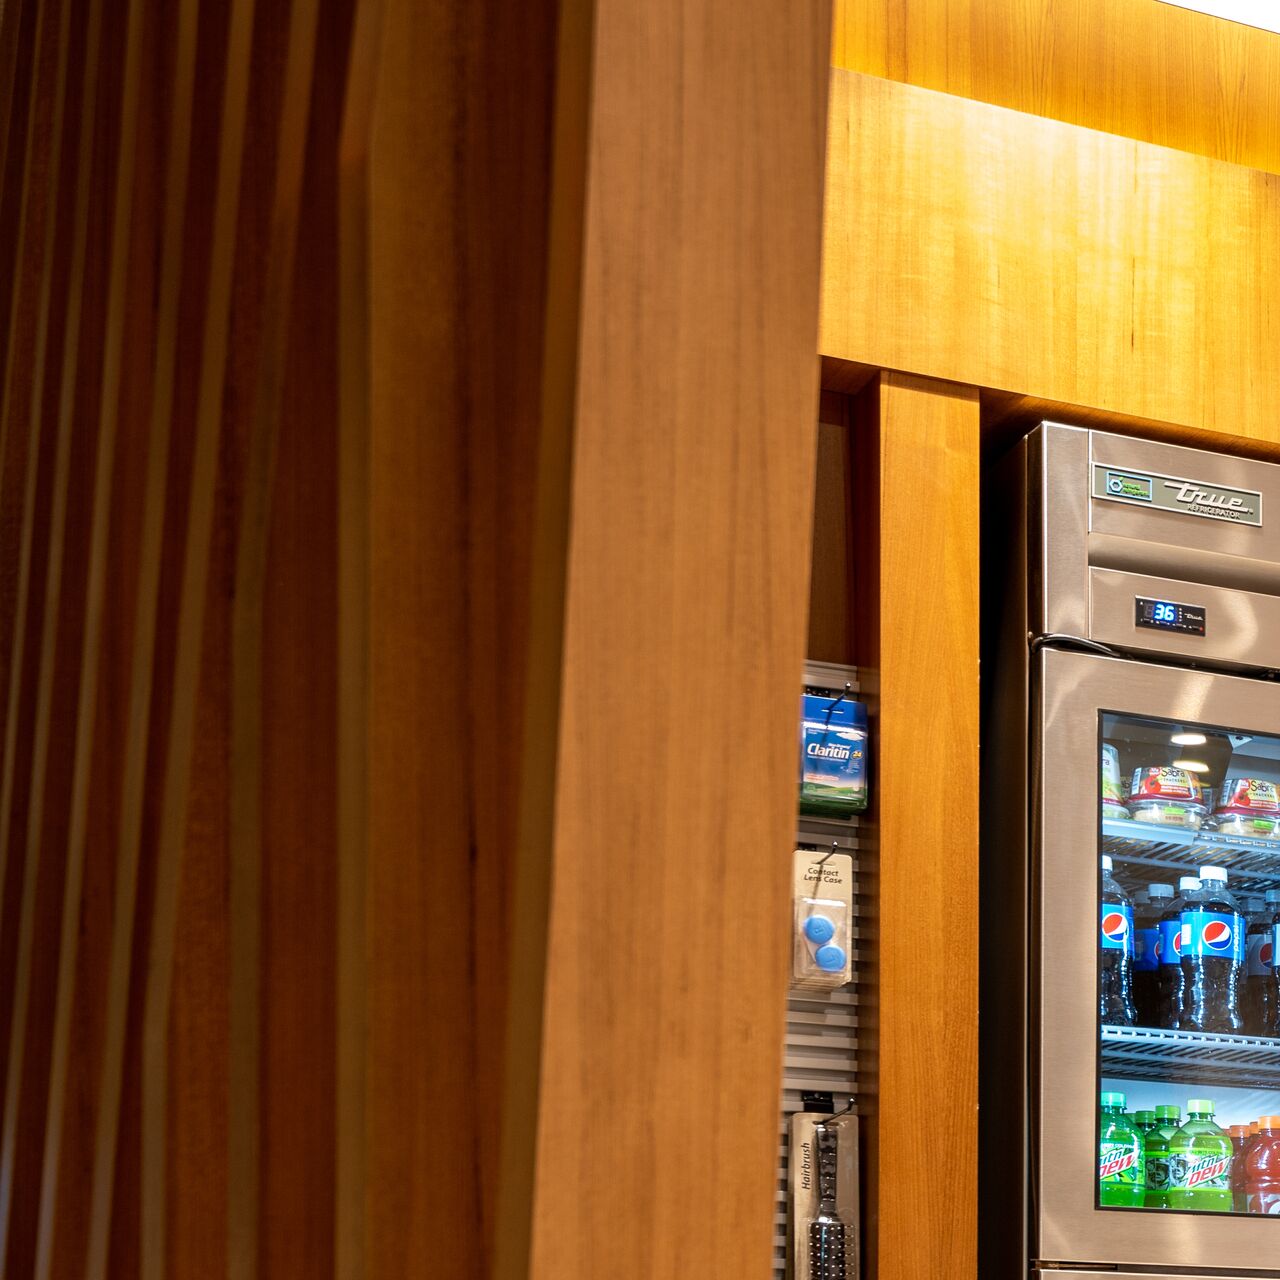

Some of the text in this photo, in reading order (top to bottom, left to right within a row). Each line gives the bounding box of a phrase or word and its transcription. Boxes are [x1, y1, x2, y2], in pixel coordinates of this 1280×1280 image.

[1188, 504, 1240, 519] REFRIGERATOR
[1154, 604, 1174, 620] 36
[807, 743, 850, 759] Claritin
[1161, 767, 1185, 777] Sabra
[804, 875, 842, 884] Lens Case
[808, 868, 838, 877] Contact
[801, 1142, 811, 1190] Hairbrush
